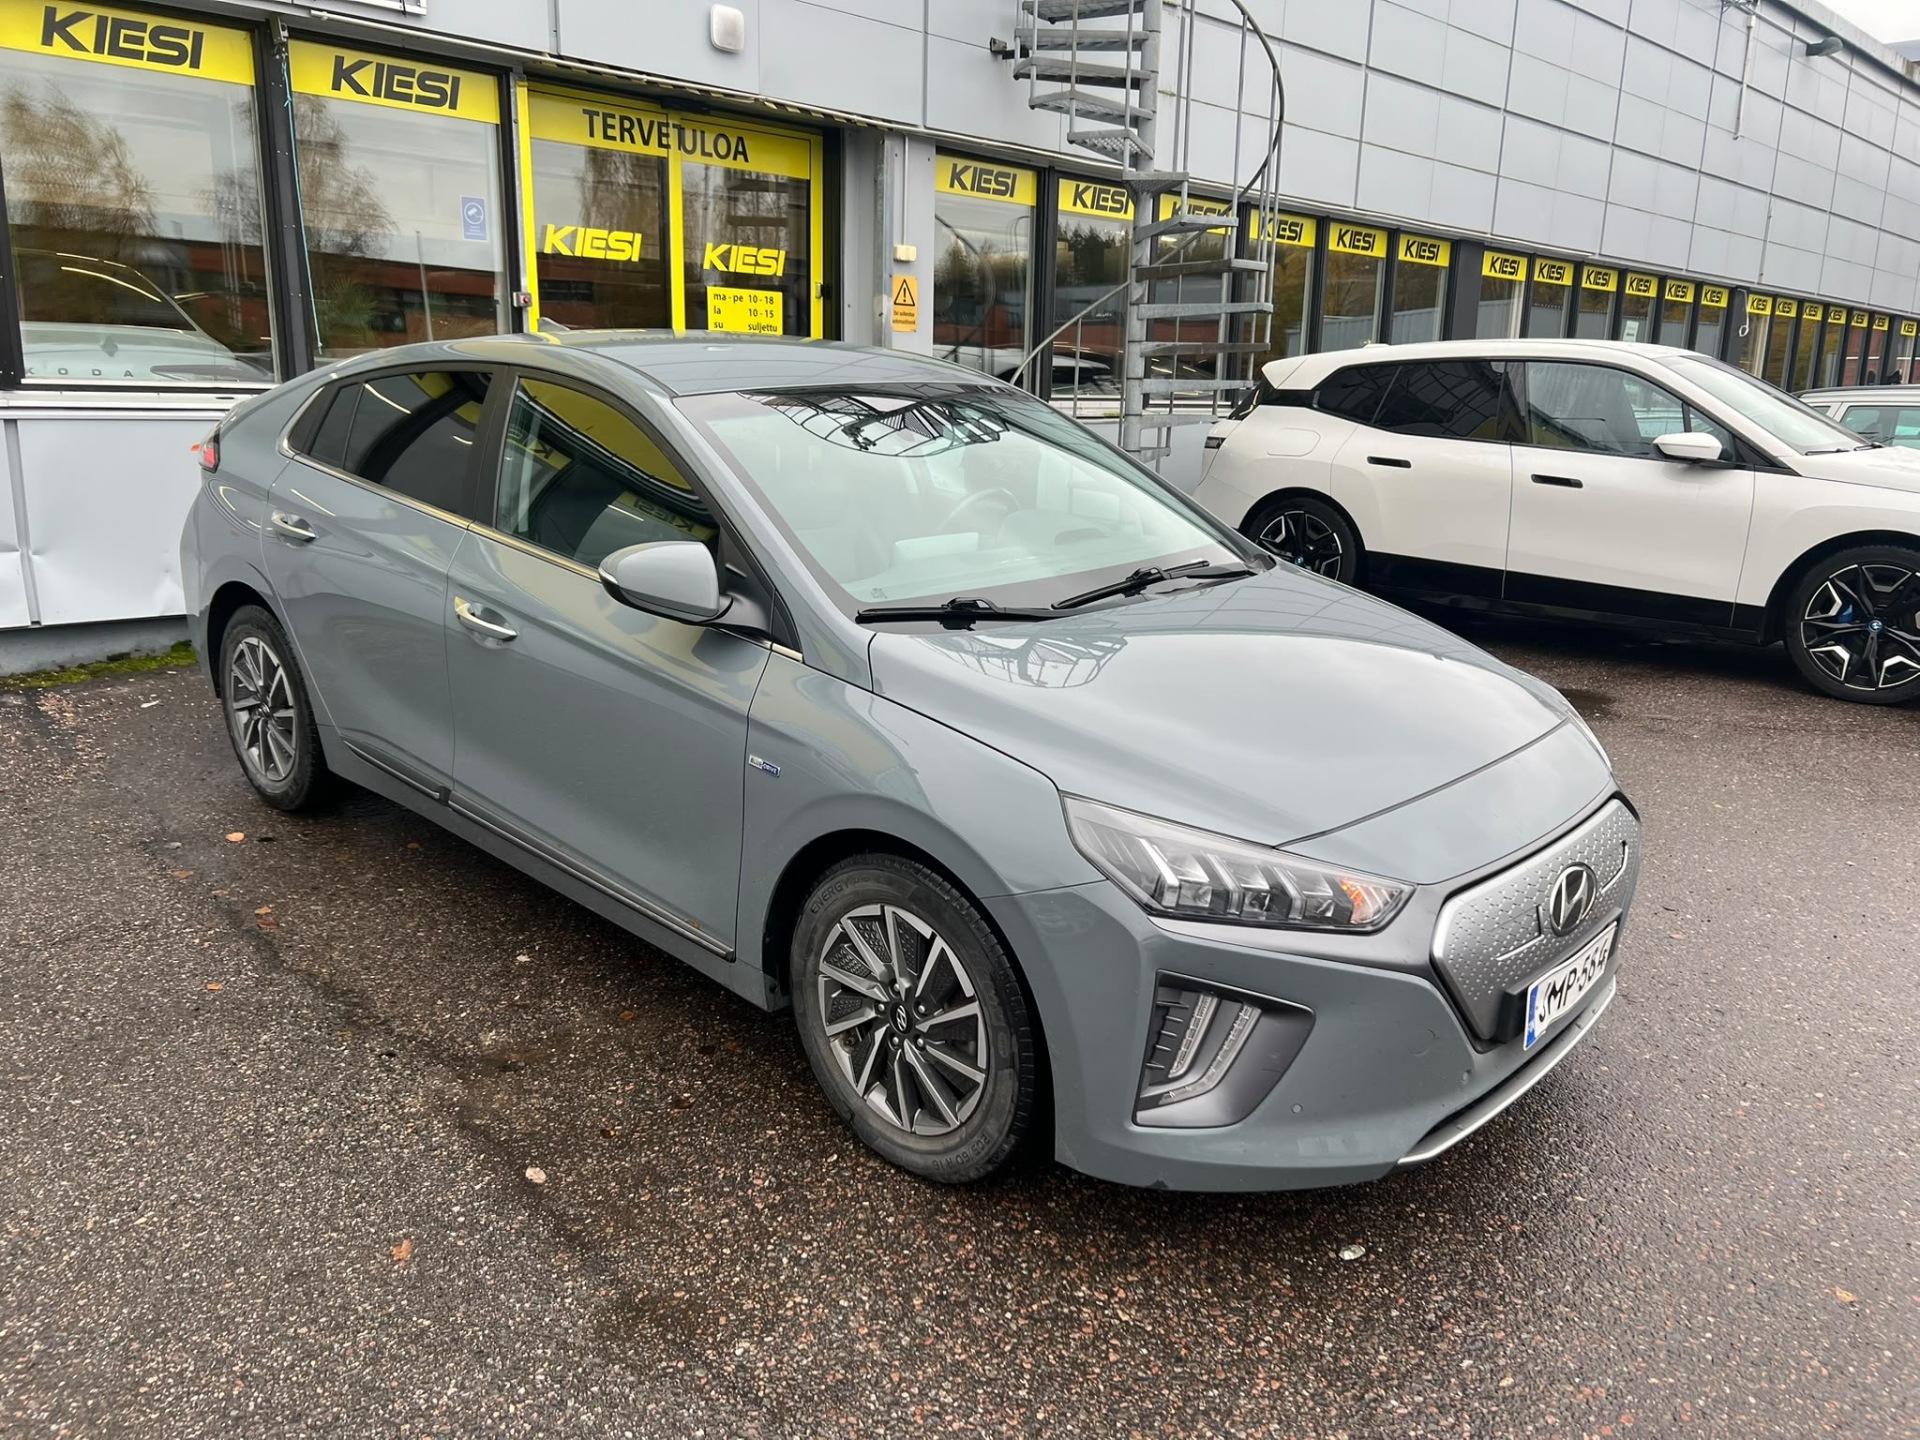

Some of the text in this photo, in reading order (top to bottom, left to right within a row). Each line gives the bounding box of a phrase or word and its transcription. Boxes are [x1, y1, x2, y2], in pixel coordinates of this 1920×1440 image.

[41, 6, 204, 70] KIESI
[331, 55, 461, 110] KIESI
[583, 109, 749, 163] TERVETULOA
[948, 163, 1017, 198] KIESI
[1072, 183, 1129, 215] KIESI
[1261, 216, 1304, 242] KESI
[1337, 228, 1376, 252] KIESI
[544, 223, 642, 262] KIESI
[1404, 239, 1440, 262] KIESI
[703, 242, 786, 277] KIESI
[1489, 256, 1520, 276] KIESI
[1538, 263, 1566, 282] KIESI
[1585, 269, 1611, 287] KIESI
[1628, 276, 1651, 294] KIESI
[713, 305, 721, 315] la
[713, 321, 778, 333] su suljettu
[810, 878, 850, 914] ENERGY
